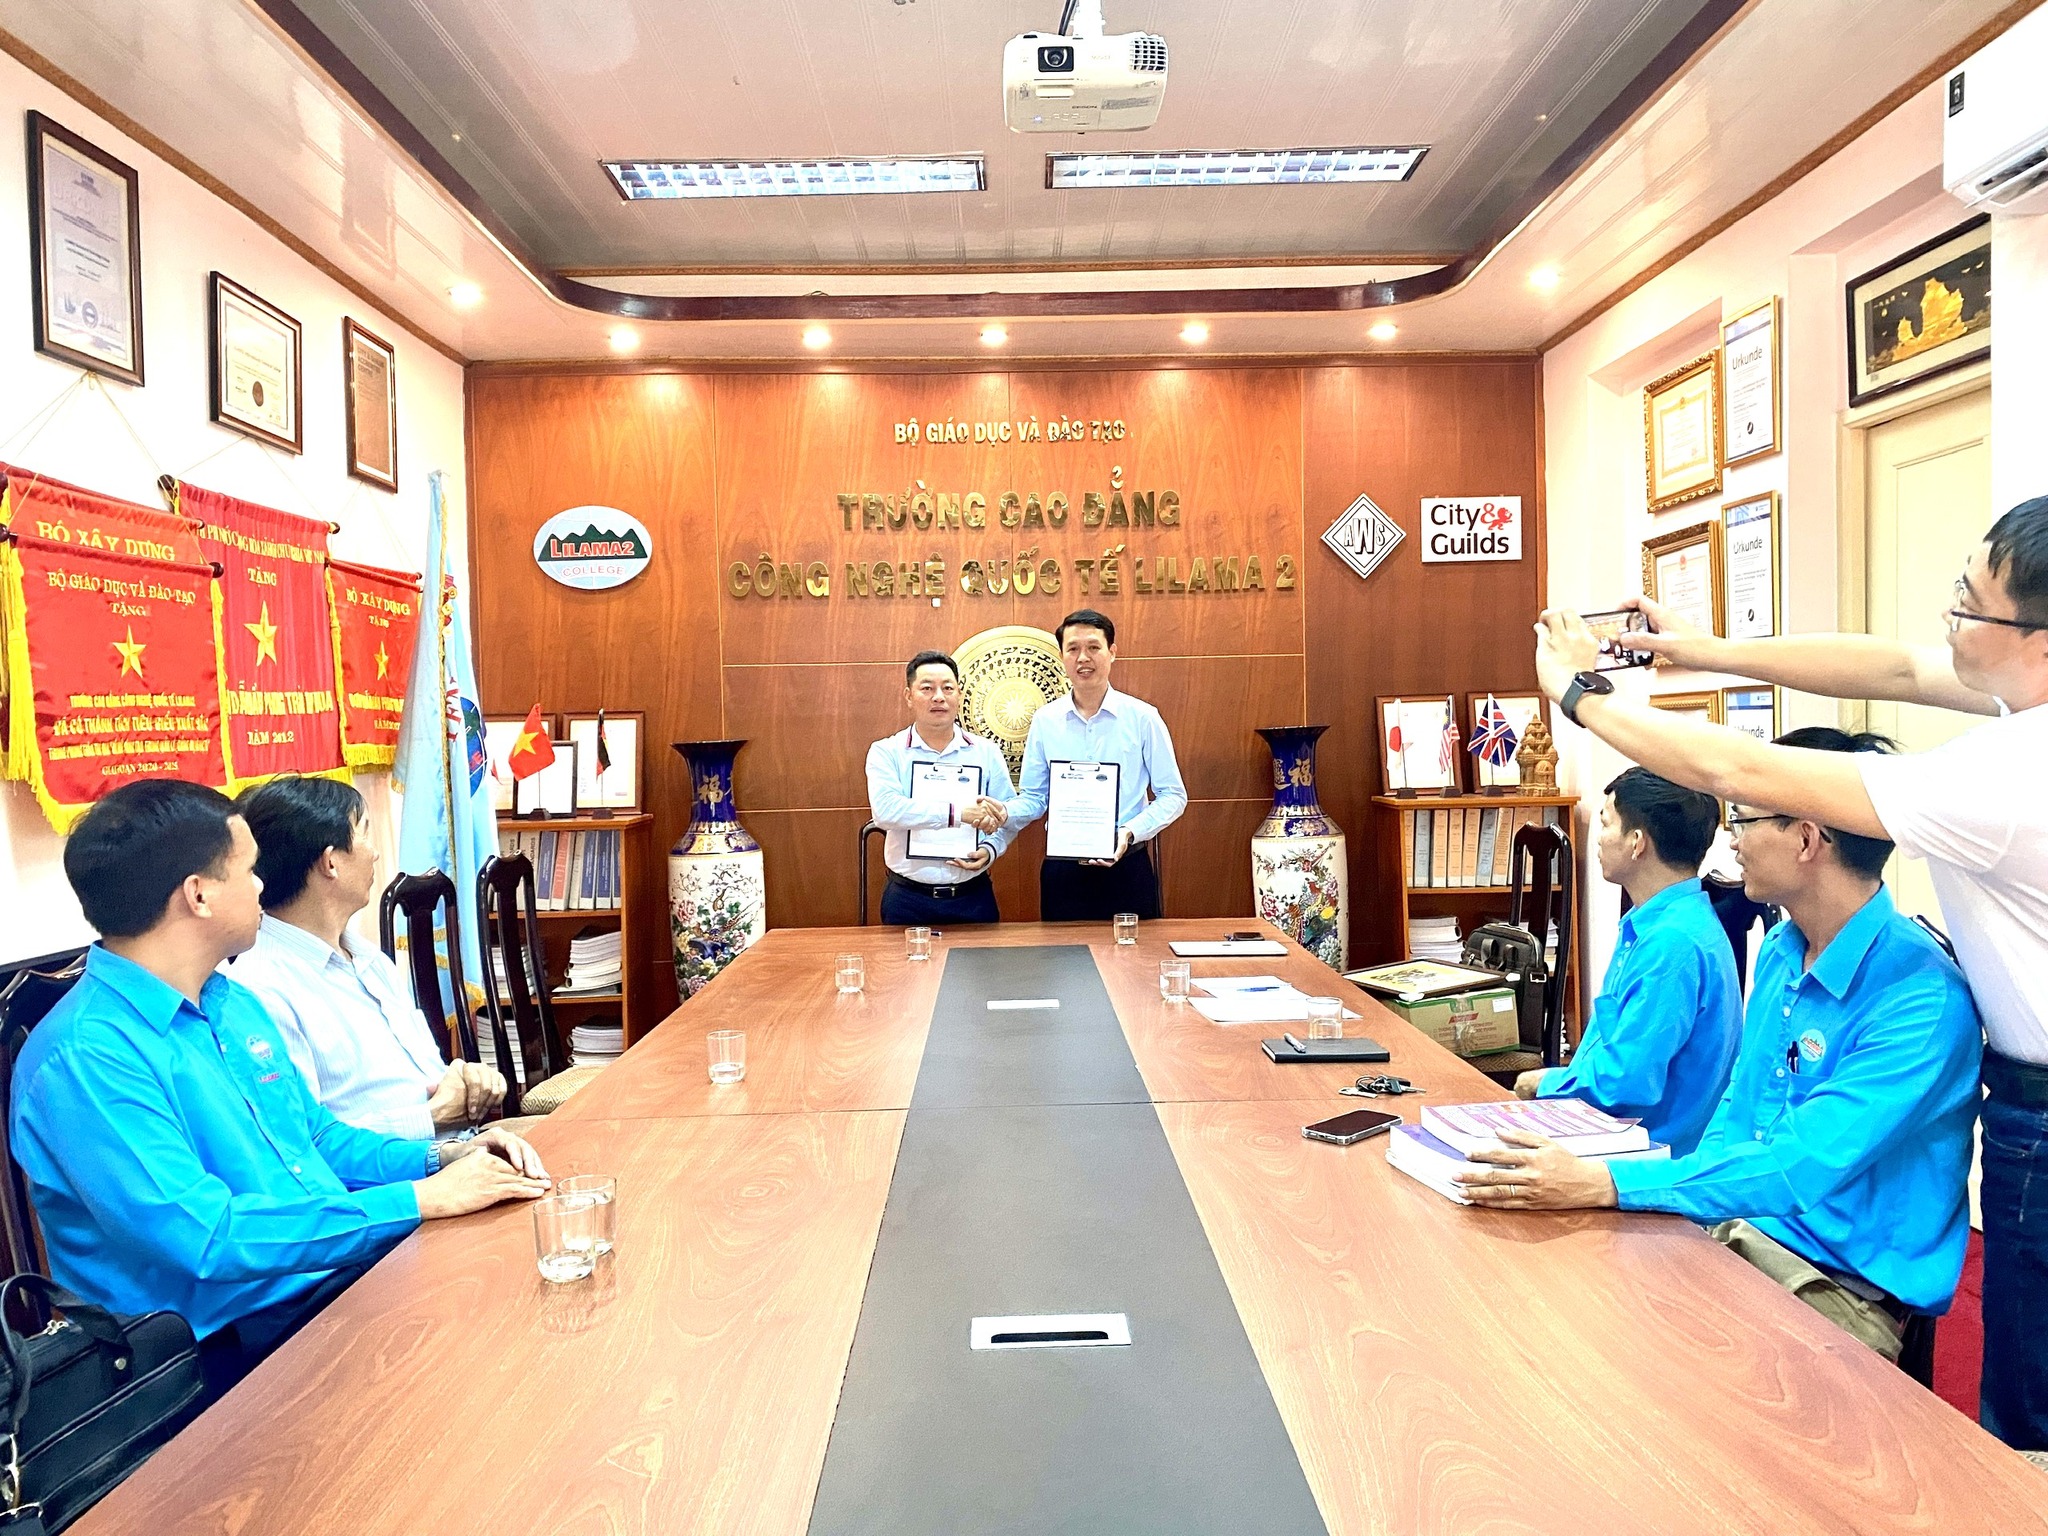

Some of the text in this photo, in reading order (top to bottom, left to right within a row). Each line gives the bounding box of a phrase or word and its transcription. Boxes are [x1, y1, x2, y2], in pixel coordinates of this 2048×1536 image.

[1732, 346, 1763, 370] Urkunde
[894, 415, 1126, 446] BỘ GIÁO DỤC VÀ ĐÀO TẠO
[837, 465, 1180, 528] TRƯỜNG CAO ĐẲNG
[76, 528, 122, 552] XÂY
[550, 538, 635, 558] LILAMA2
[1343, 517, 1386, 555] AWS
[1430, 532, 1509, 555] Guilds
[1733, 536, 1763, 555] Urkunde
[247, 566, 277, 588] TẶNG
[562, 565, 624, 577] COLLEGE
[727, 543, 1296, 608] CÔNG NGHỆ QUỐC TẾ LILAMA 2
[47, 567, 196, 606] BỘ GIÁO DỤC VÀ ĐÀO TẠO
[110, 601, 147, 618] TẶNG
[346, 586, 411, 616] BỘ XÂY DỰNG
[1288, 757, 1313, 787] 福
